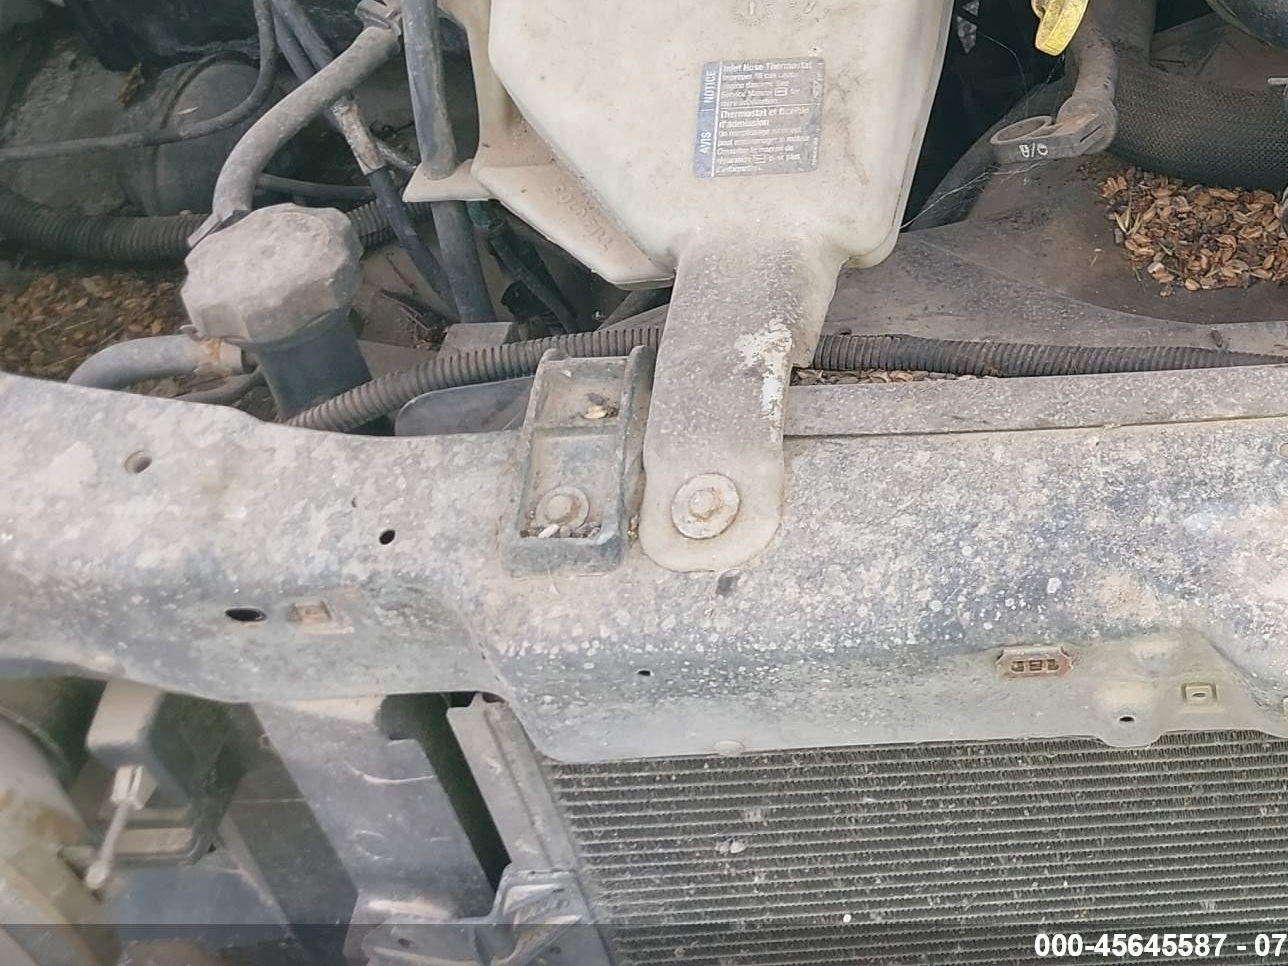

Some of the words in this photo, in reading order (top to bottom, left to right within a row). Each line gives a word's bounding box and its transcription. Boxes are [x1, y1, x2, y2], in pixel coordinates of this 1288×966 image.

[723, 64, 742, 72] Inlet
[743, 63, 764, 71] Hose
[767, 61, 812, 70] Thermostat
[704, 70, 716, 103] NOTICE
[720, 109, 767, 118] Thermostat
[699, 131, 712, 154] AVIS
